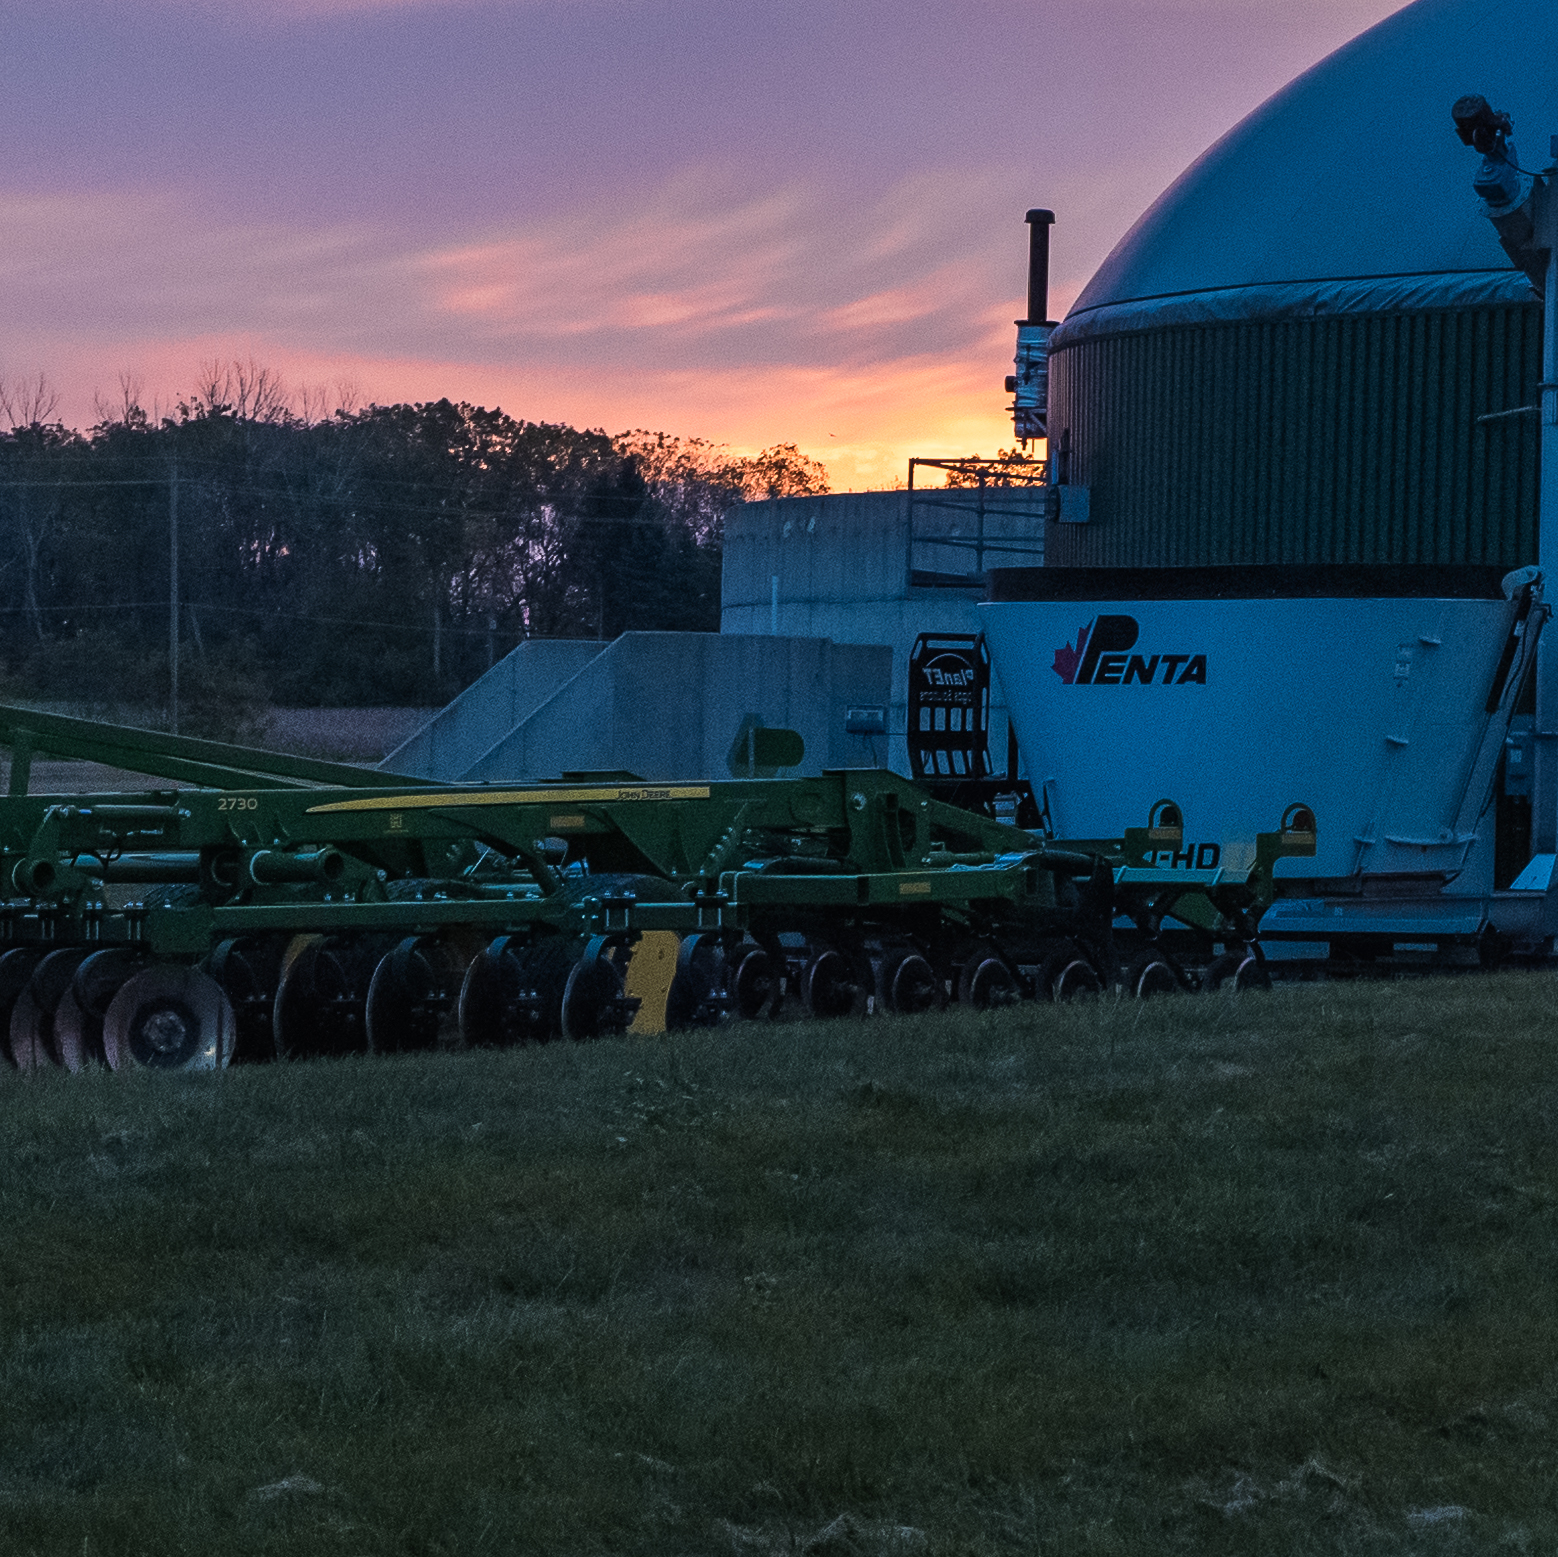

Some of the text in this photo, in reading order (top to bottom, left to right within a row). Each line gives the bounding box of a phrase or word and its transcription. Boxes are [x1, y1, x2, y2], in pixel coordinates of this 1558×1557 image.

[1075, 615, 1206, 684] PENTA
[616, 789, 671, 800] JOHN DEERE
[217, 798, 258, 810] 2730
